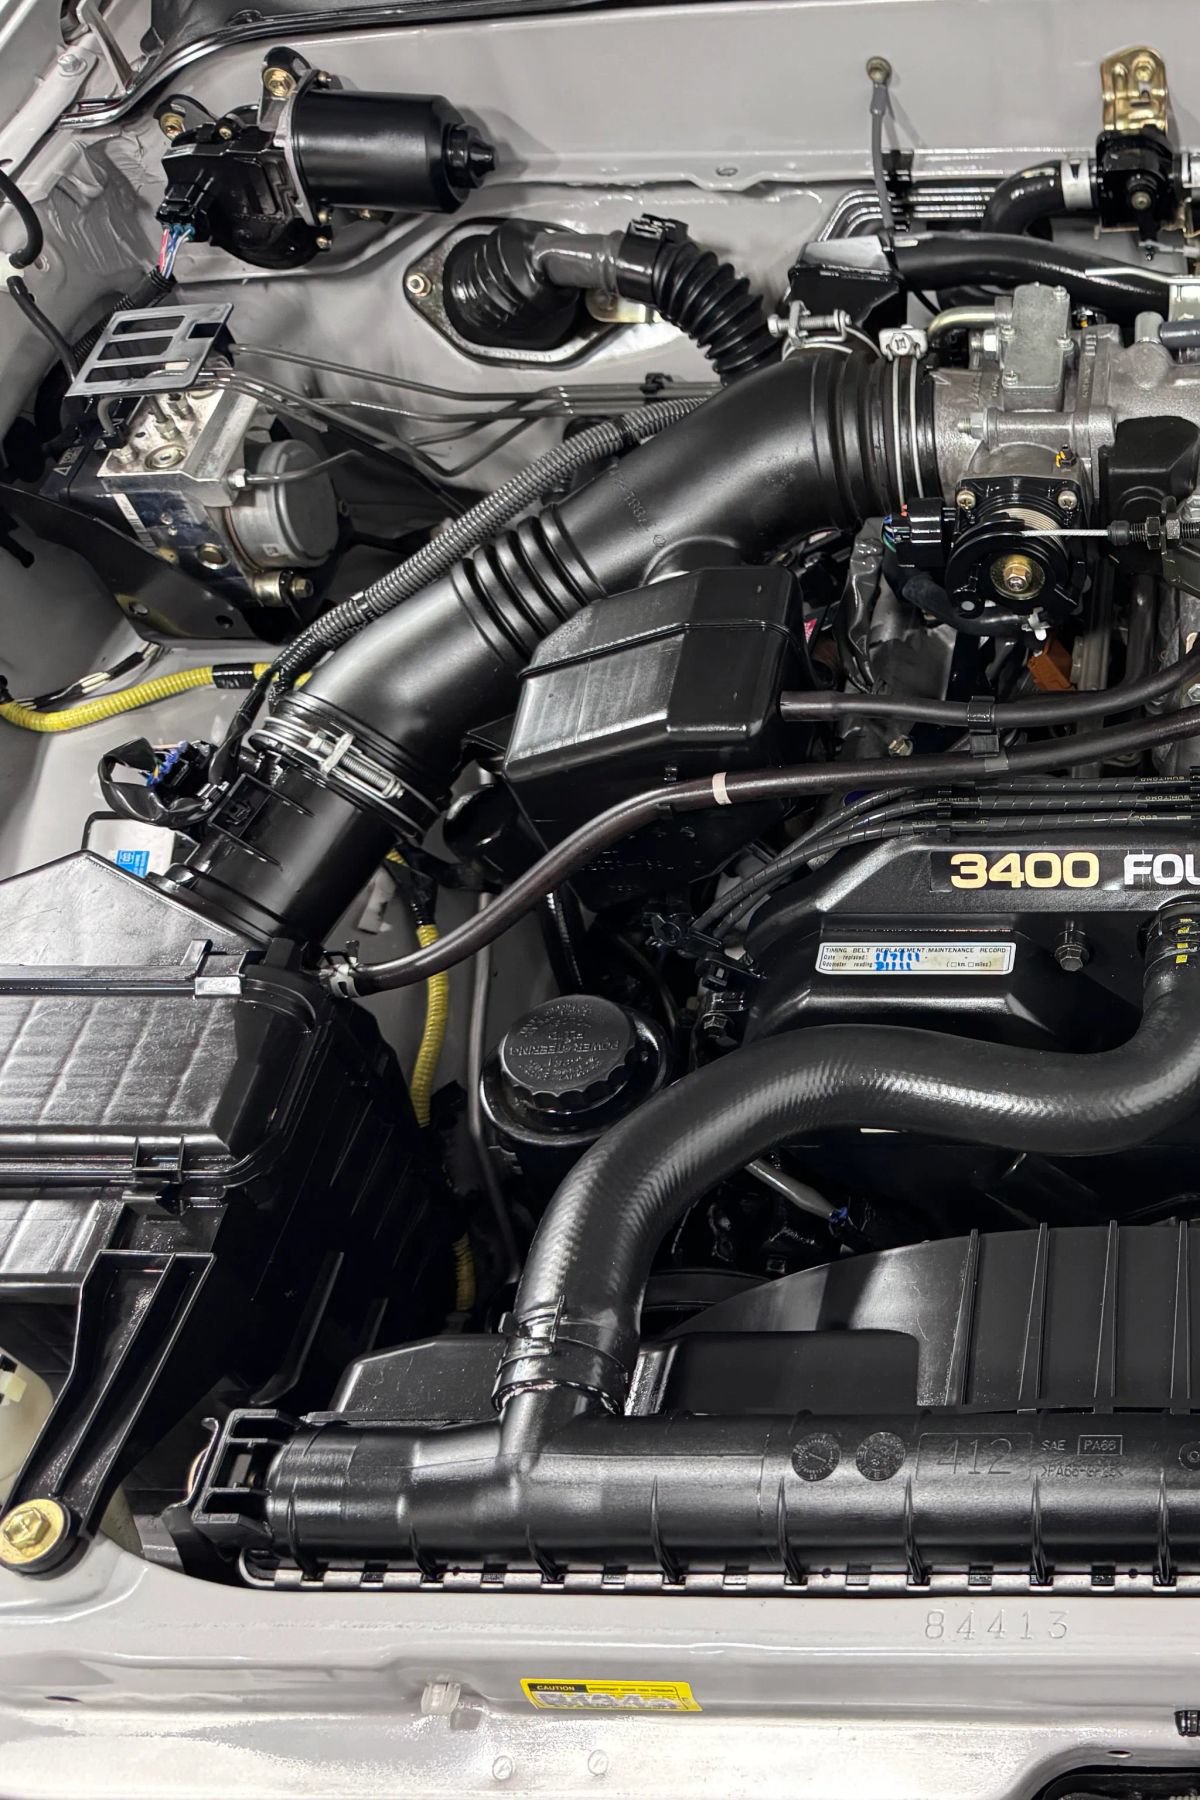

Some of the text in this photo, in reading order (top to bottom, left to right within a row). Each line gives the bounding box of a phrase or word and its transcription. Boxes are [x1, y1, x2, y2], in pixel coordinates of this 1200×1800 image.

[950, 851, 1100, 888] 3400
[937, 1437, 1012, 1475] 412
[1041, 1439, 1116, 1451] SAE PA66
[924, 1608, 1070, 1640] 84413
[536, 1684, 576, 1692] CAUTION
